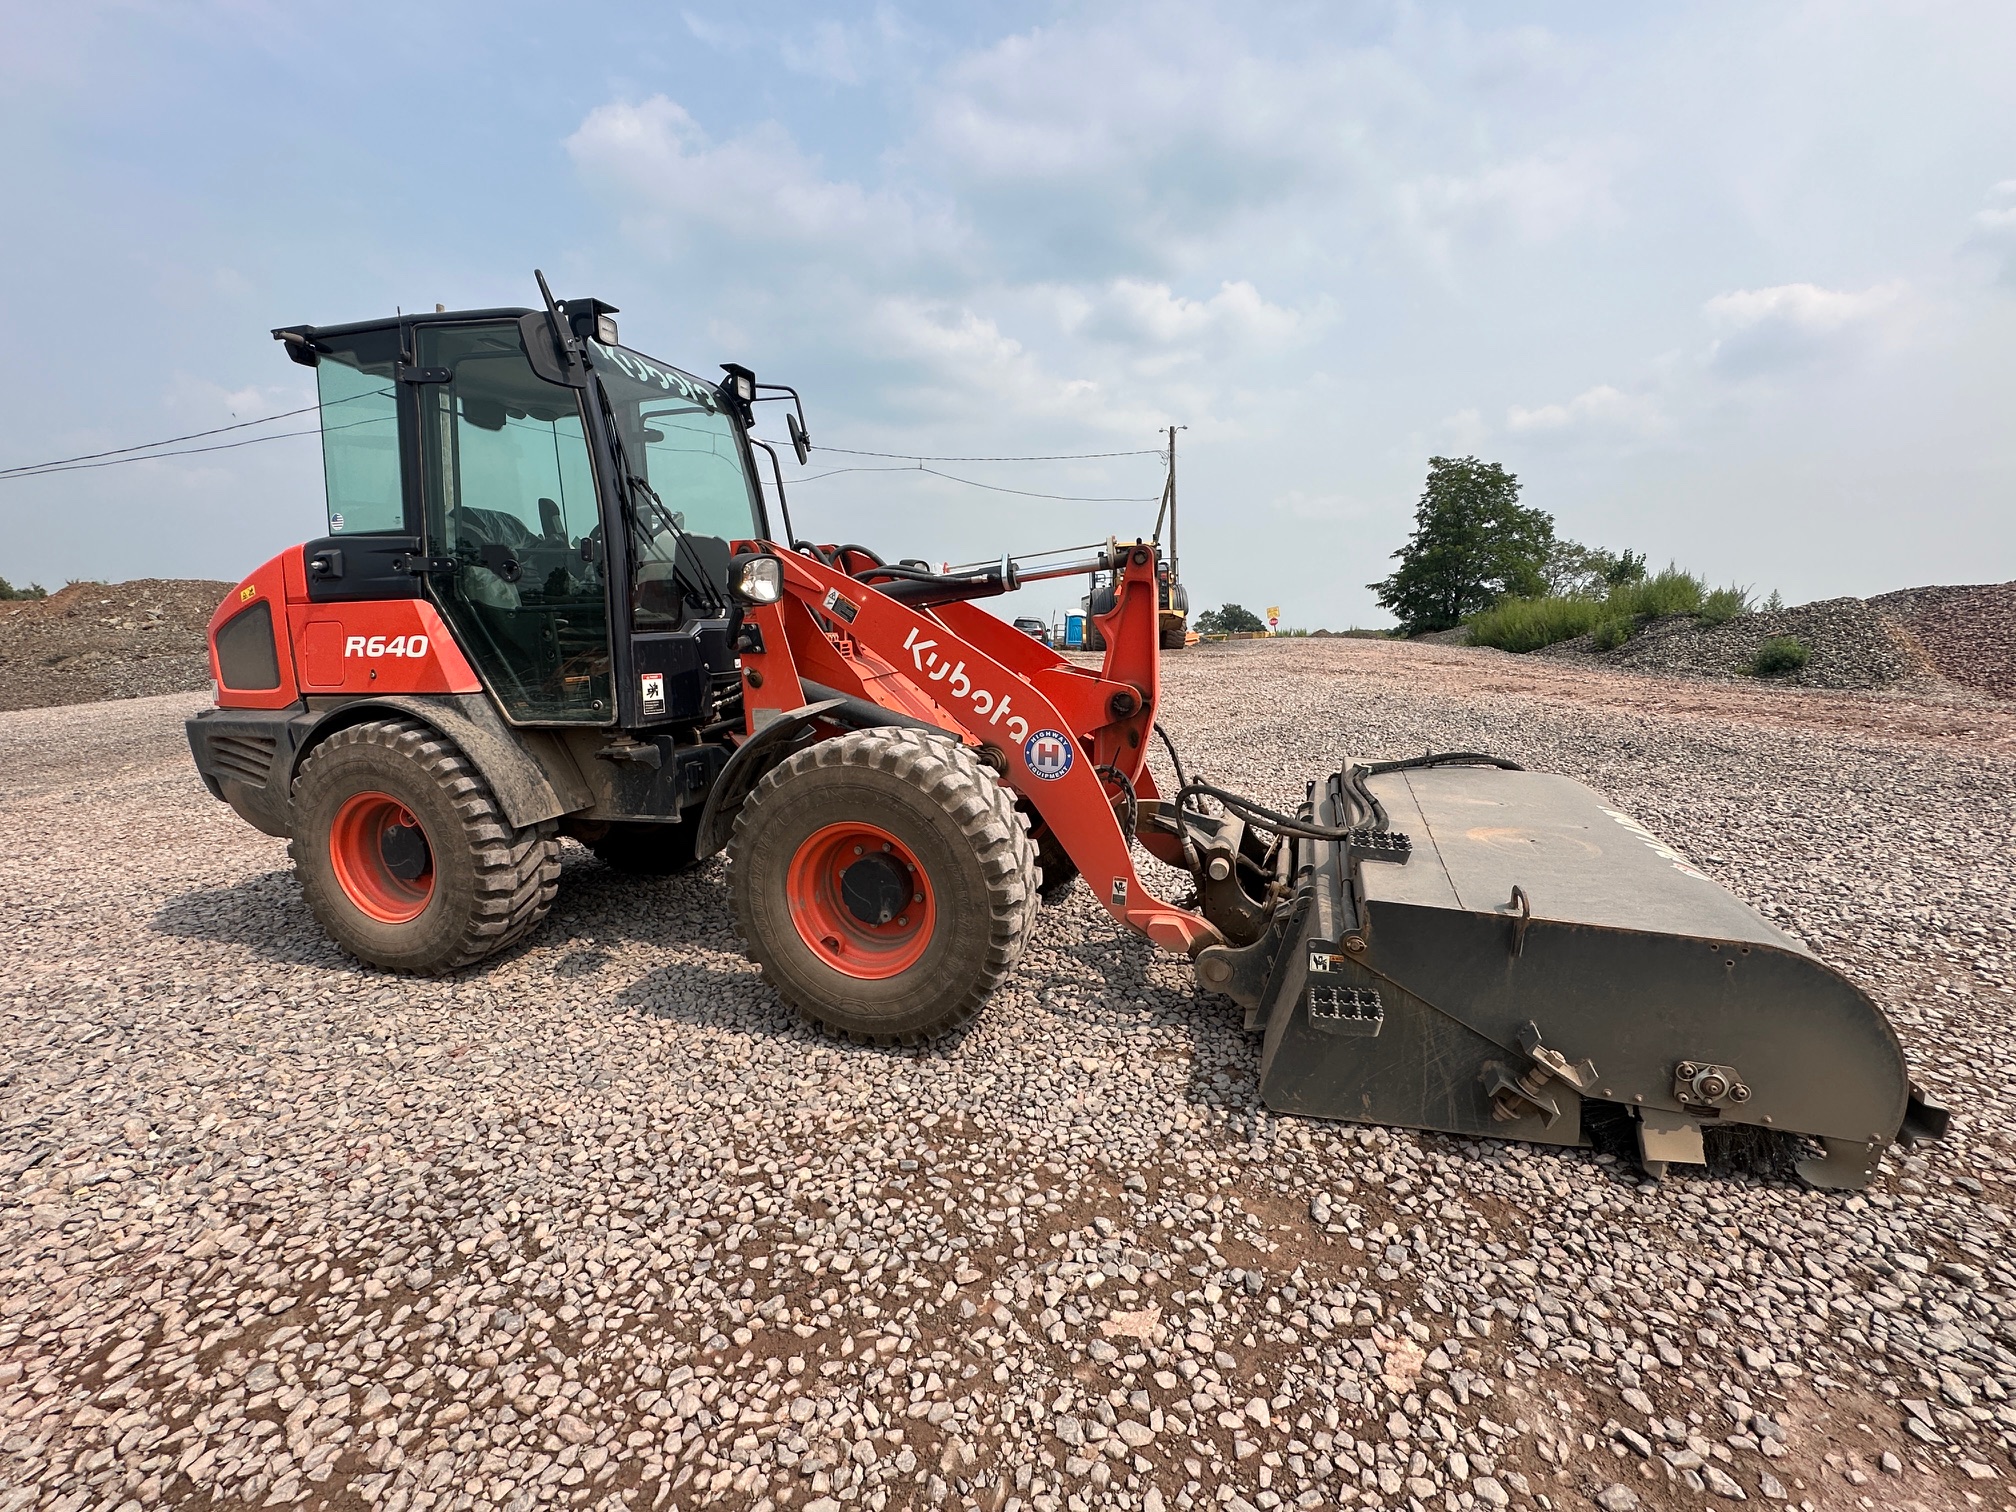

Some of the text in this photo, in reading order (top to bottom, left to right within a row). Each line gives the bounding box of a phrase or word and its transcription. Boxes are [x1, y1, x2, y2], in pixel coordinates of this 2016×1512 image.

[587, 335, 718, 408] Kubota
[344, 634, 429, 658] R640
[902, 626, 1029, 745] Kubota
[1030, 731, 1068, 746] HIGHWAY
[1037, 743, 1059, 767] H
[1028, 762, 1068, 779] EQUIPMENT
